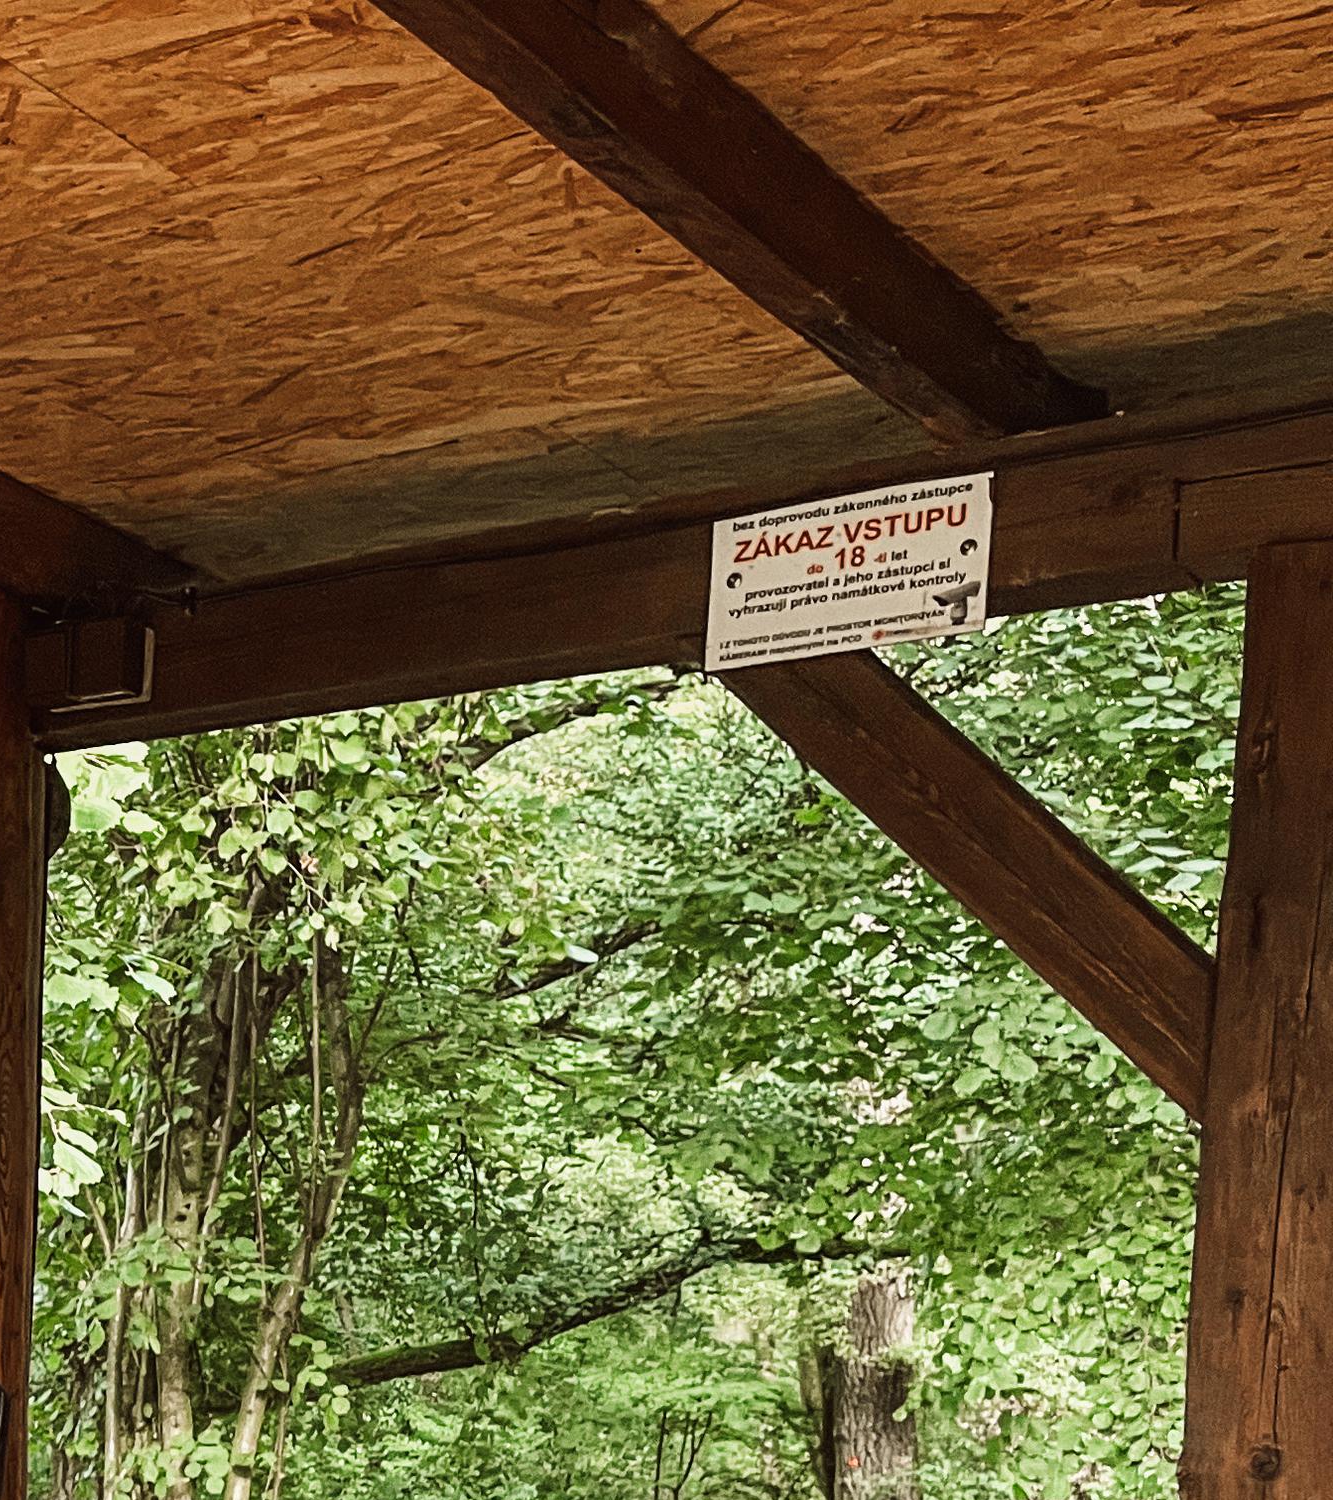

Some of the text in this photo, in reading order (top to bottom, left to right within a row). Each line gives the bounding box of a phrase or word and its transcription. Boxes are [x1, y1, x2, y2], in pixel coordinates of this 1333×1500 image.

[732, 483, 973, 532] bez doprovodu zákonného zástupce
[732, 503, 967, 562] ZÁKAZ VSTUPU
[744, 557, 951, 602] provozovatel a jeho zástupci si
[806, 564, 824, 575] do
[833, 545, 865, 569] 18
[890, 549, 908, 561] let
[790, 594, 828, 609] právo
[831, 579, 905, 600] namátkové
[908, 571, 966, 588] kontroly
